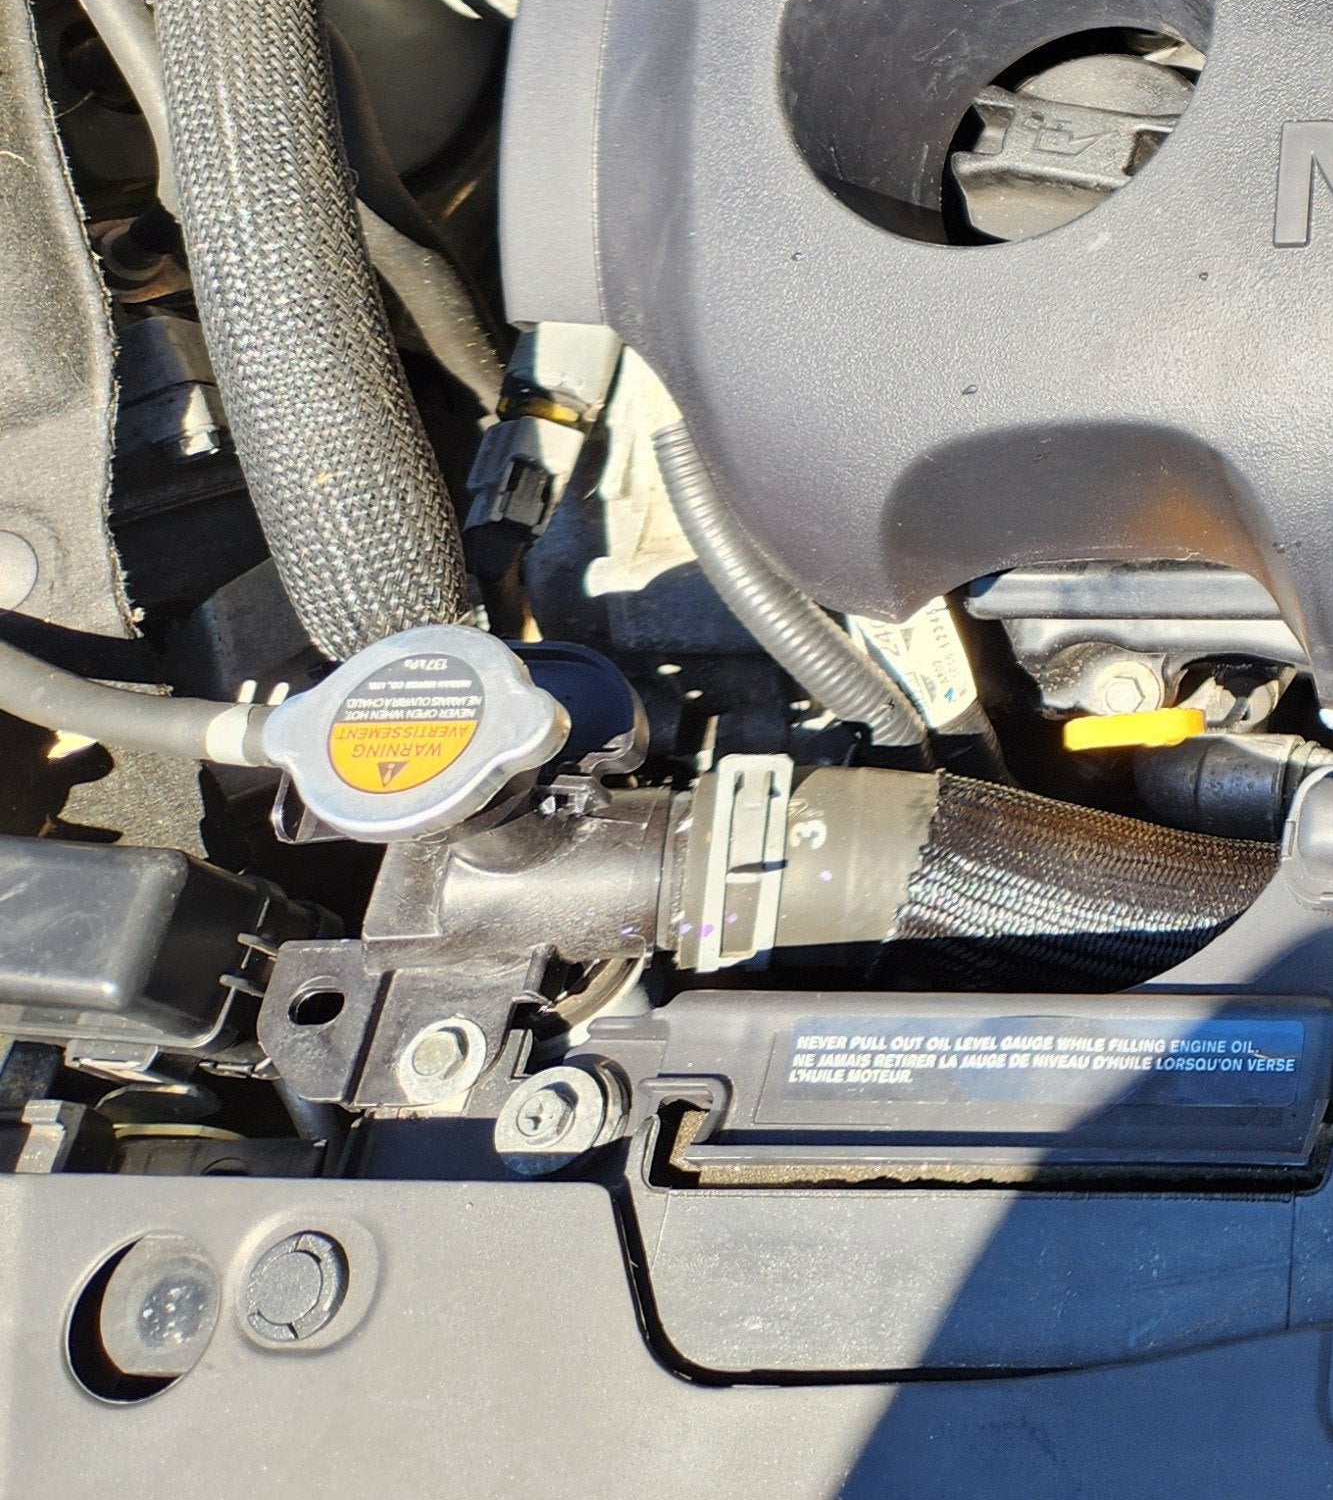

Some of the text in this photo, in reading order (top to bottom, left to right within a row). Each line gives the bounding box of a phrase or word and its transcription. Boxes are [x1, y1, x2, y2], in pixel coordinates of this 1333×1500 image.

[466, 696, 482, 705] NE
[344, 708, 476, 720] NEVER OPEN WHEN HOT.
[335, 725, 468, 740] AVERTISSEMENT
[351, 743, 442, 758] WARNING
[796, 1036, 1260, 1054] NEVER PULL OUT OIL LEVEL GAUGE WHILE FILLING ENGINE OIL.
[792, 1054, 1296, 1072] NE JAMAIS RETIRER LA JAUGE DE NIVEAU D'HUILE LORSQU'ON VERSE
[788, 1069, 914, 1084] L'HUILE MOTEUR.
